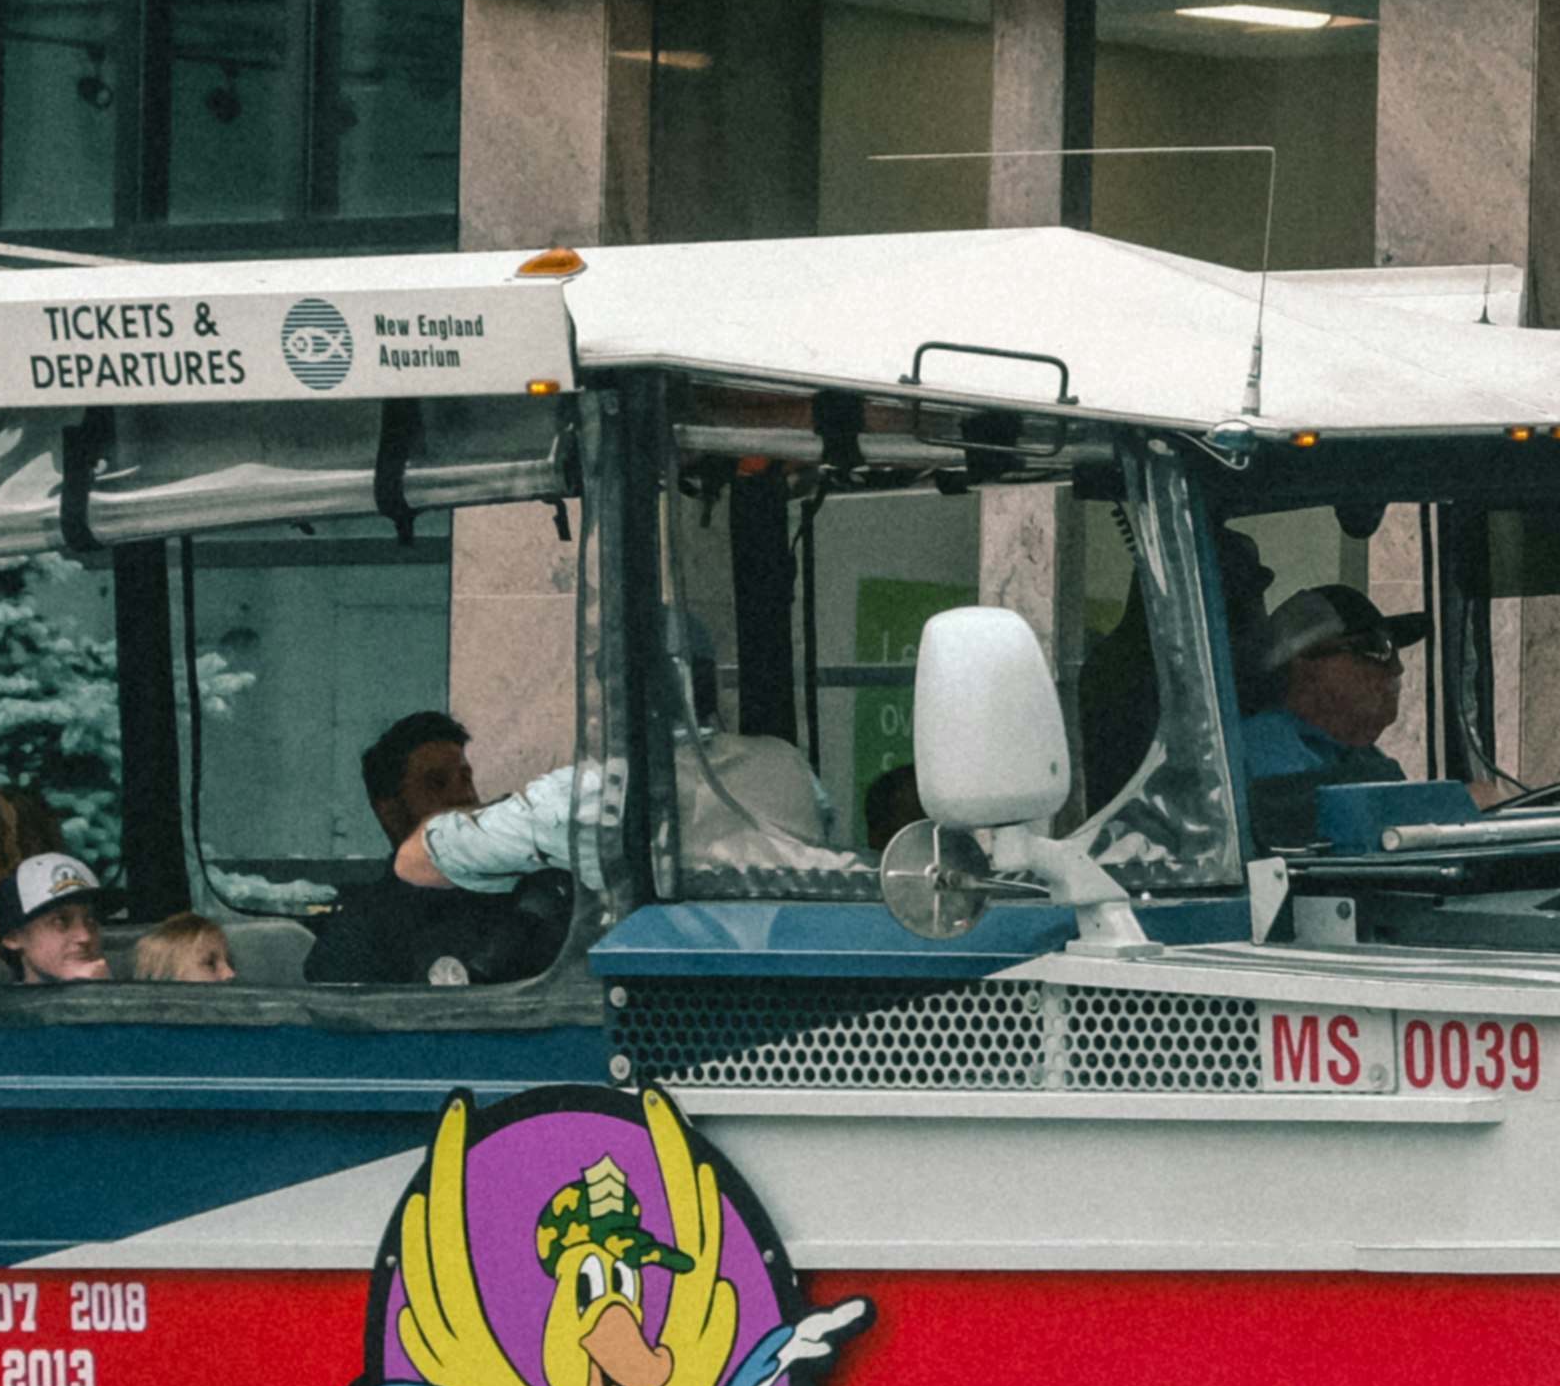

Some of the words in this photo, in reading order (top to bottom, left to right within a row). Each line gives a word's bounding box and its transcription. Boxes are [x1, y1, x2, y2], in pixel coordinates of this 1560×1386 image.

[44, 303, 174, 341] TICKETS
[193, 302, 220, 337] &
[374, 315, 410, 336] New
[418, 313, 485, 340] England
[30, 349, 246, 389] DEPARTURES
[379, 344, 461, 370] Aquarium
[1271, 1014, 1361, 1086] MS
[1404, 1019, 1539, 1091] 0039
[69, 1281, 148, 1332] 2018
